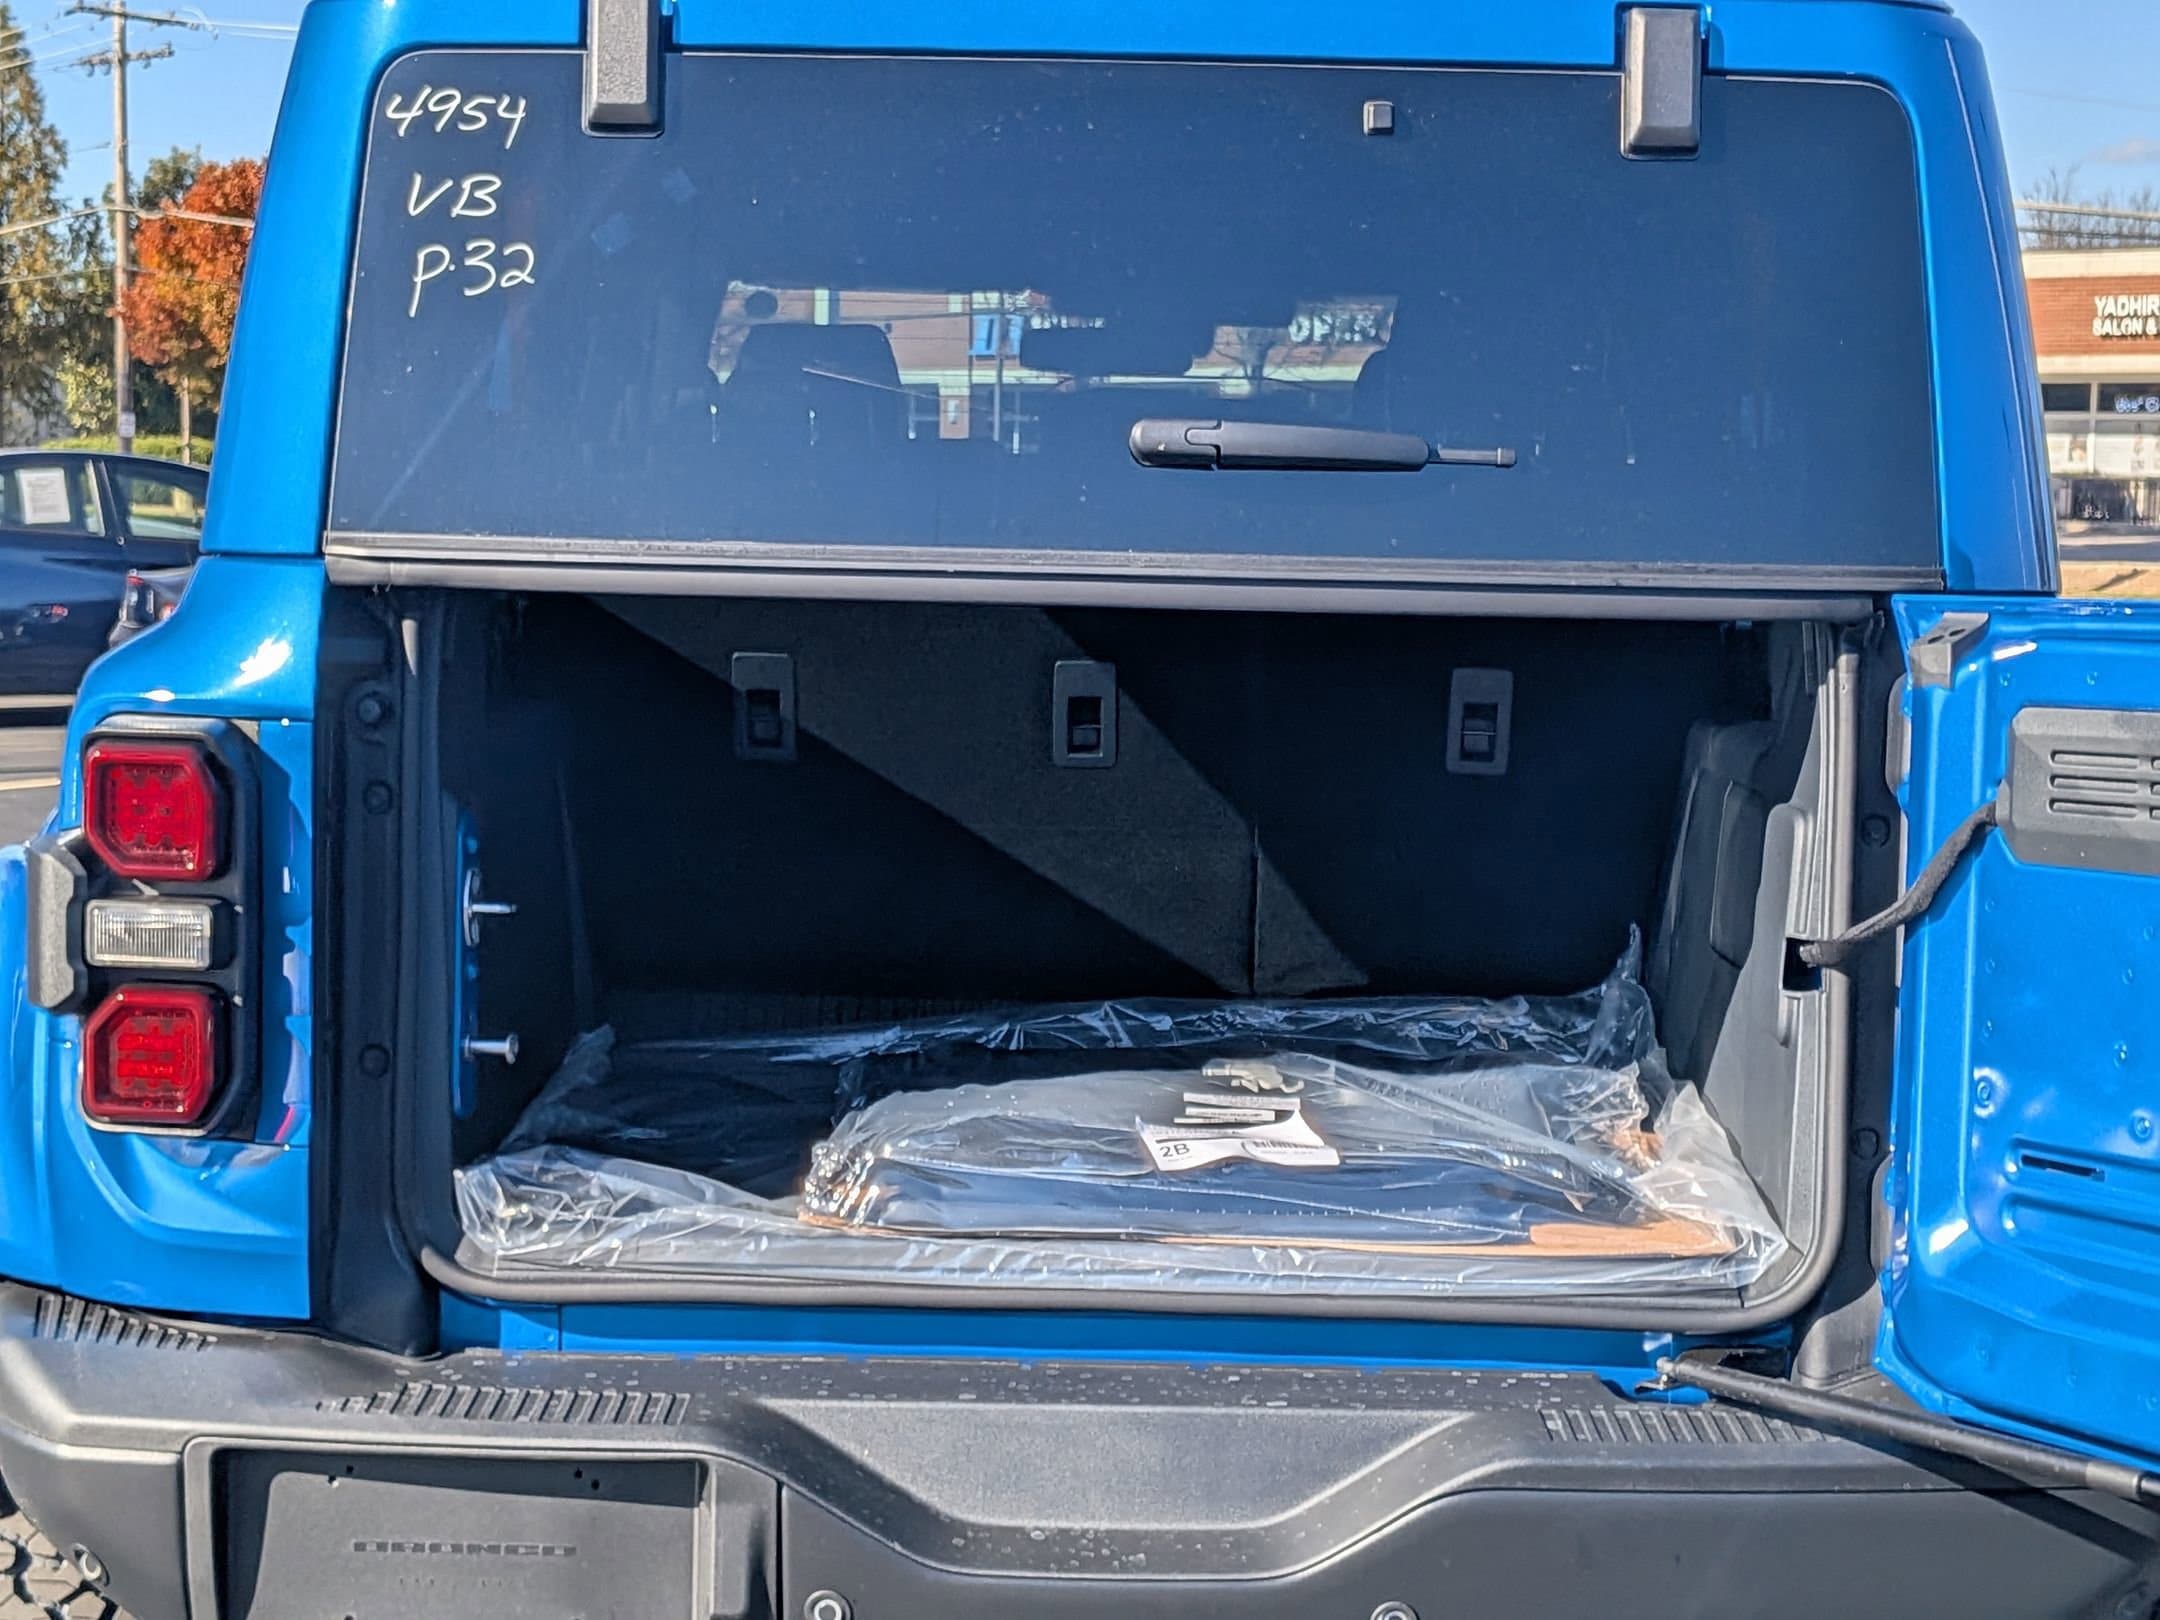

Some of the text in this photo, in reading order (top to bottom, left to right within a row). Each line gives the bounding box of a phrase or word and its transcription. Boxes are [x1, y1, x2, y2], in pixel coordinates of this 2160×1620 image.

[386, 85, 527, 149] 4954
[408, 172, 502, 217] VB
[2093, 294, 2160, 318] YADHIR
[2092, 317, 2158, 337] SALON &
[1159, 1143, 1190, 1158] 2B
